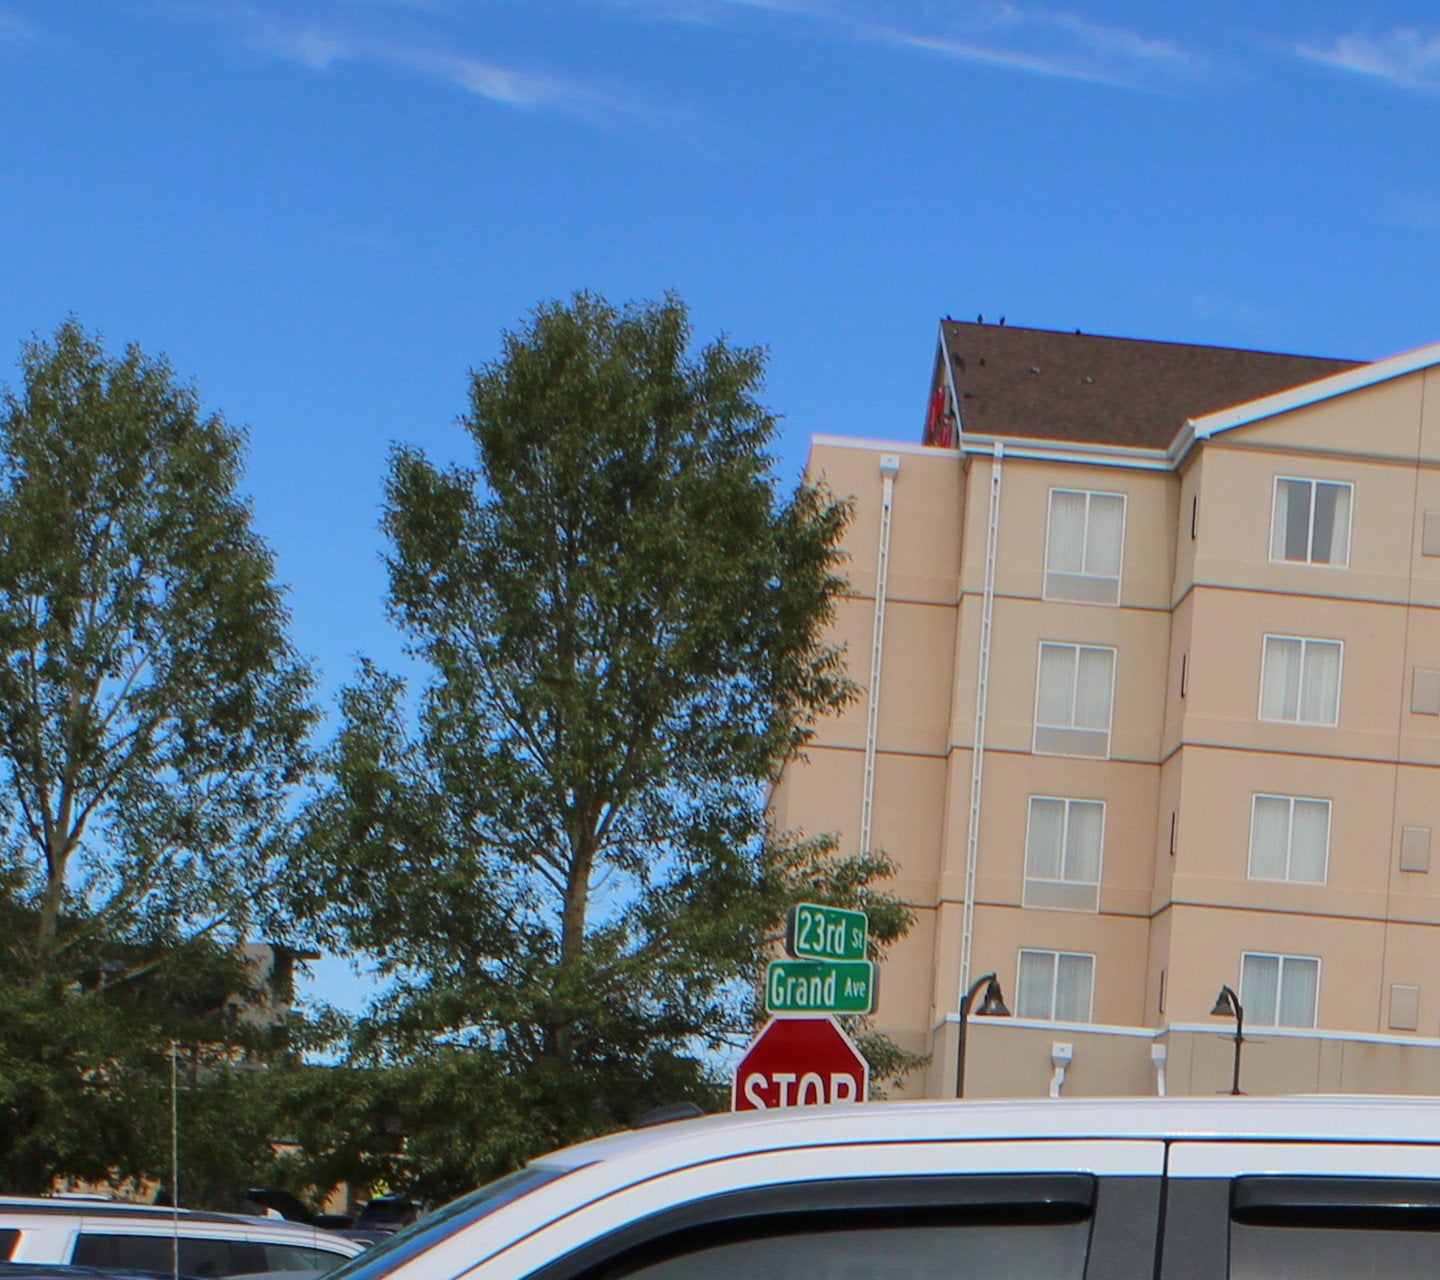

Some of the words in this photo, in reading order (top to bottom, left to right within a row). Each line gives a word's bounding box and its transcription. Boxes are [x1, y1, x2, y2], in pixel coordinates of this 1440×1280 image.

[798, 911, 846, 955] 23rd
[852, 928, 863, 949] St
[771, 967, 836, 1007] Grand
[844, 977, 867, 997] Ave
